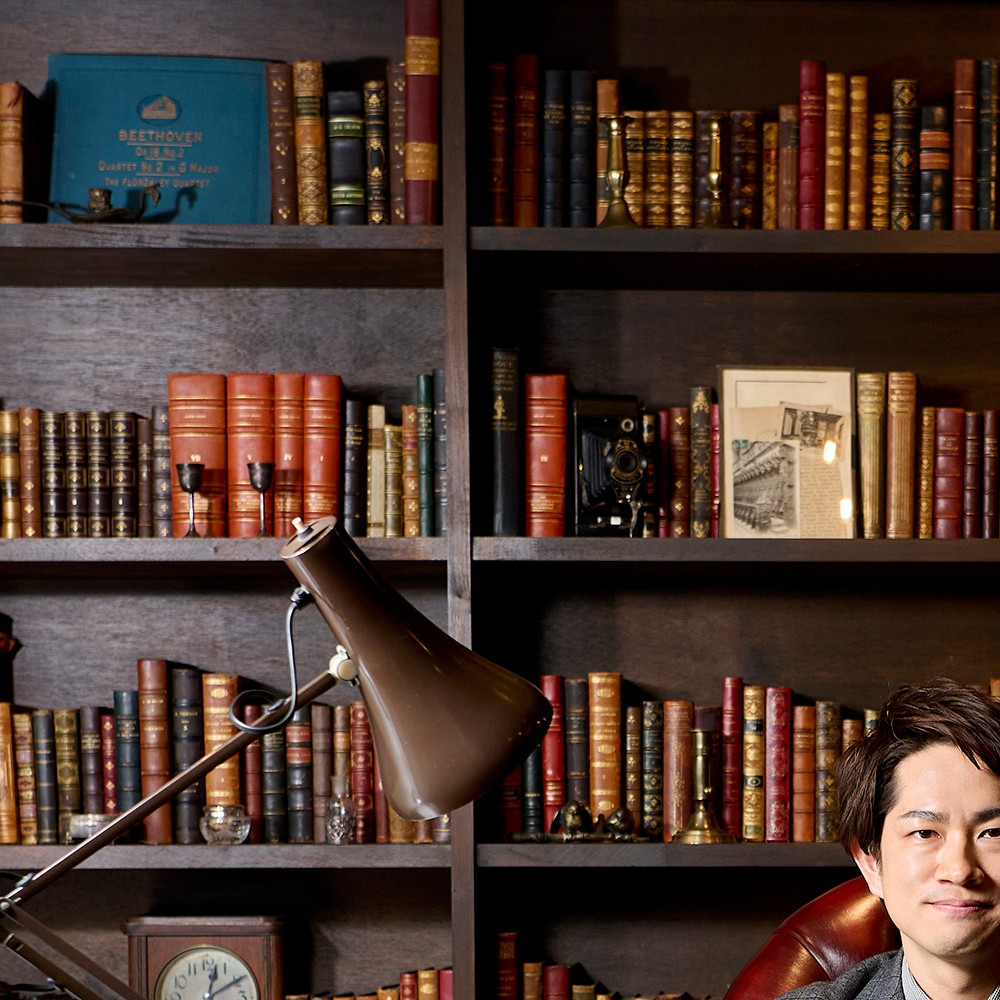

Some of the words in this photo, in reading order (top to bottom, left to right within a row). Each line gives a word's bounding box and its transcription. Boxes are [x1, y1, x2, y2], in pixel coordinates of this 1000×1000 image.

[118, 129, 203, 143] BEETHOVEN
[178, 160, 187, 173] G
[188, 962, 197, 976] 11
[202, 959, 214, 971] 12
[174, 975, 187, 990] 10
